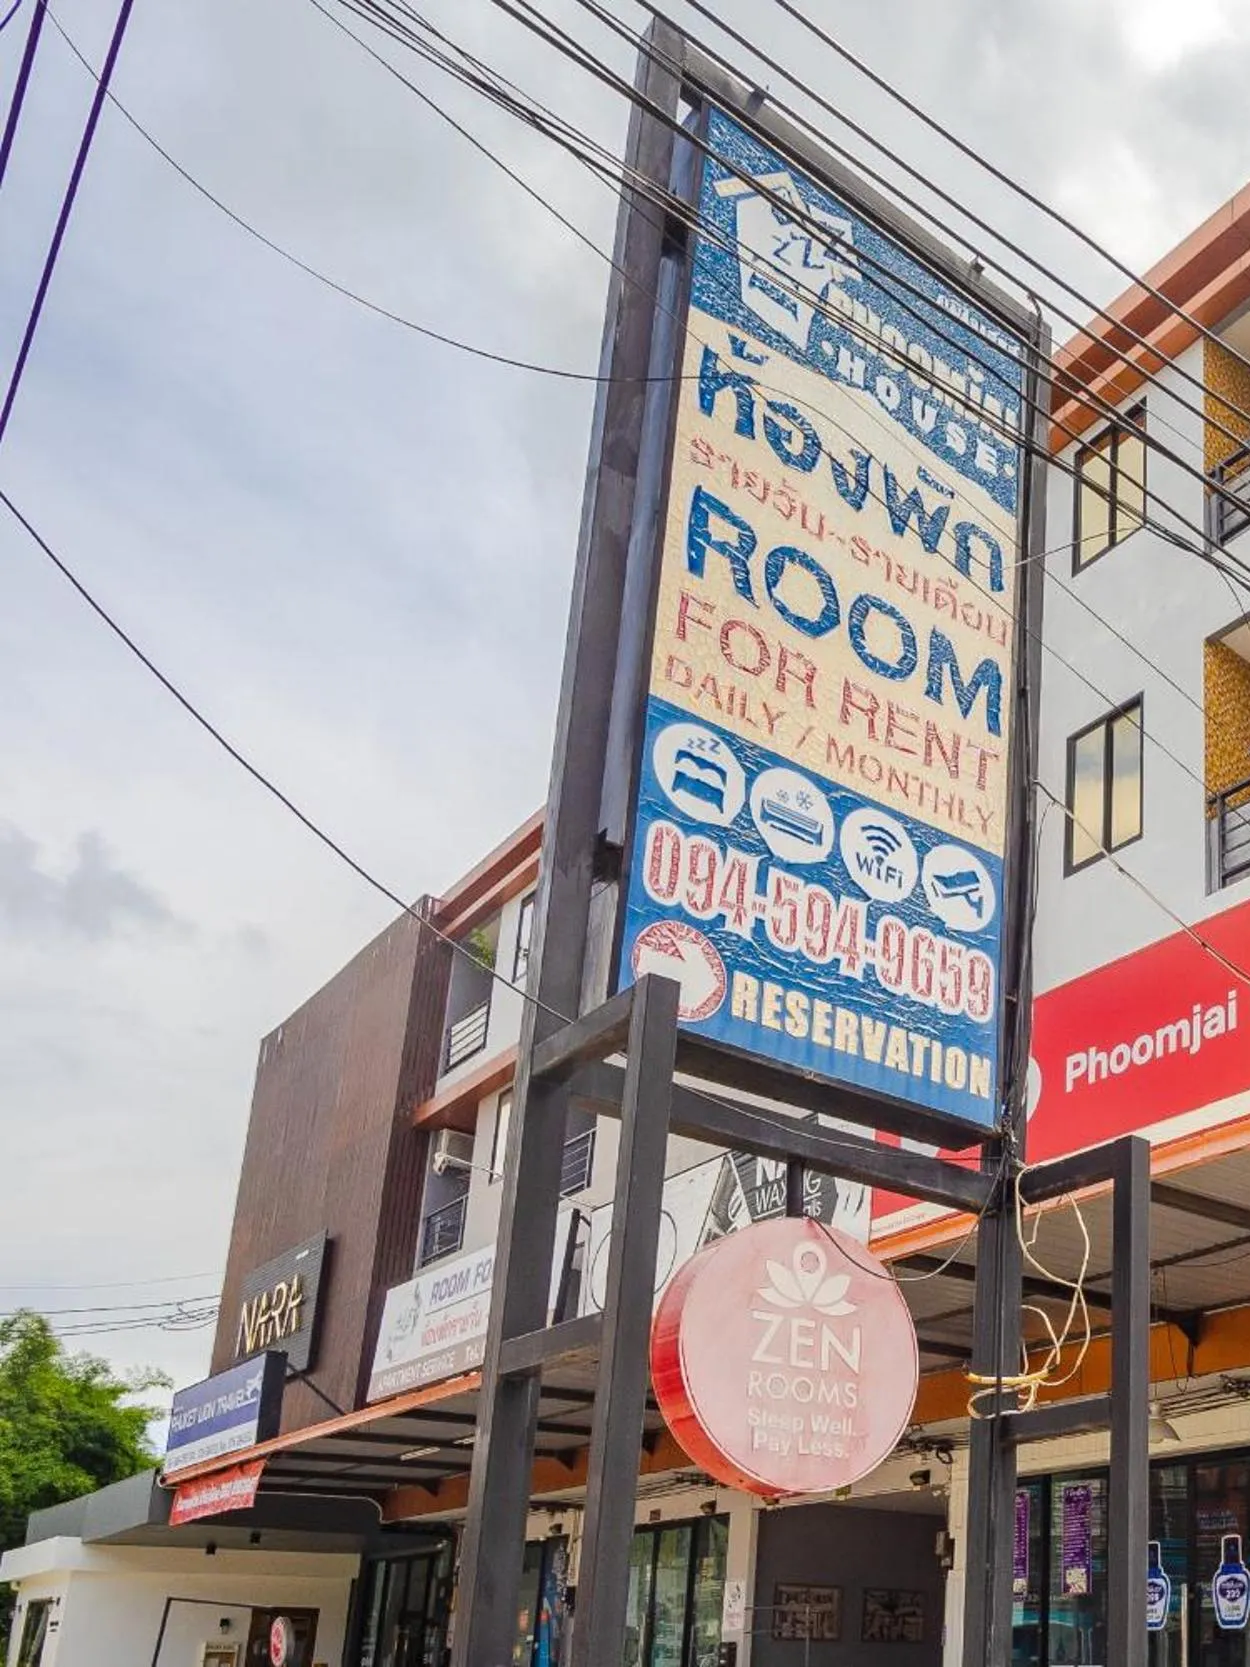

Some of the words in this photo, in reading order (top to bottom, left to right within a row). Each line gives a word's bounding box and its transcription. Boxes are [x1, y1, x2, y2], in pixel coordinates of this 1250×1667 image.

[697, 332, 1004, 592] ห้องพัก
[686, 485, 1002, 738] ROOM
[664, 654, 786, 736] DAILY
[825, 731, 996, 838] MONTHLY
[676, 588, 817, 708] FOR
[838, 676, 1000, 792] RENT
[645, 822, 994, 1020] 094-594-9659
[731, 969, 992, 1100] RESERVATION
[1064, 990, 1239, 1094] Phoomjai
[473, 1256, 493, 1287] FO
[747, 1370, 859, 1408] ROOMS
[750, 1309, 863, 1375] ZEN
[747, 1407, 804, 1435] Sleep
[811, 1413, 857, 1437] Well.
[752, 1427, 792, 1456] Pay
[797, 1435, 850, 1459] Less.
